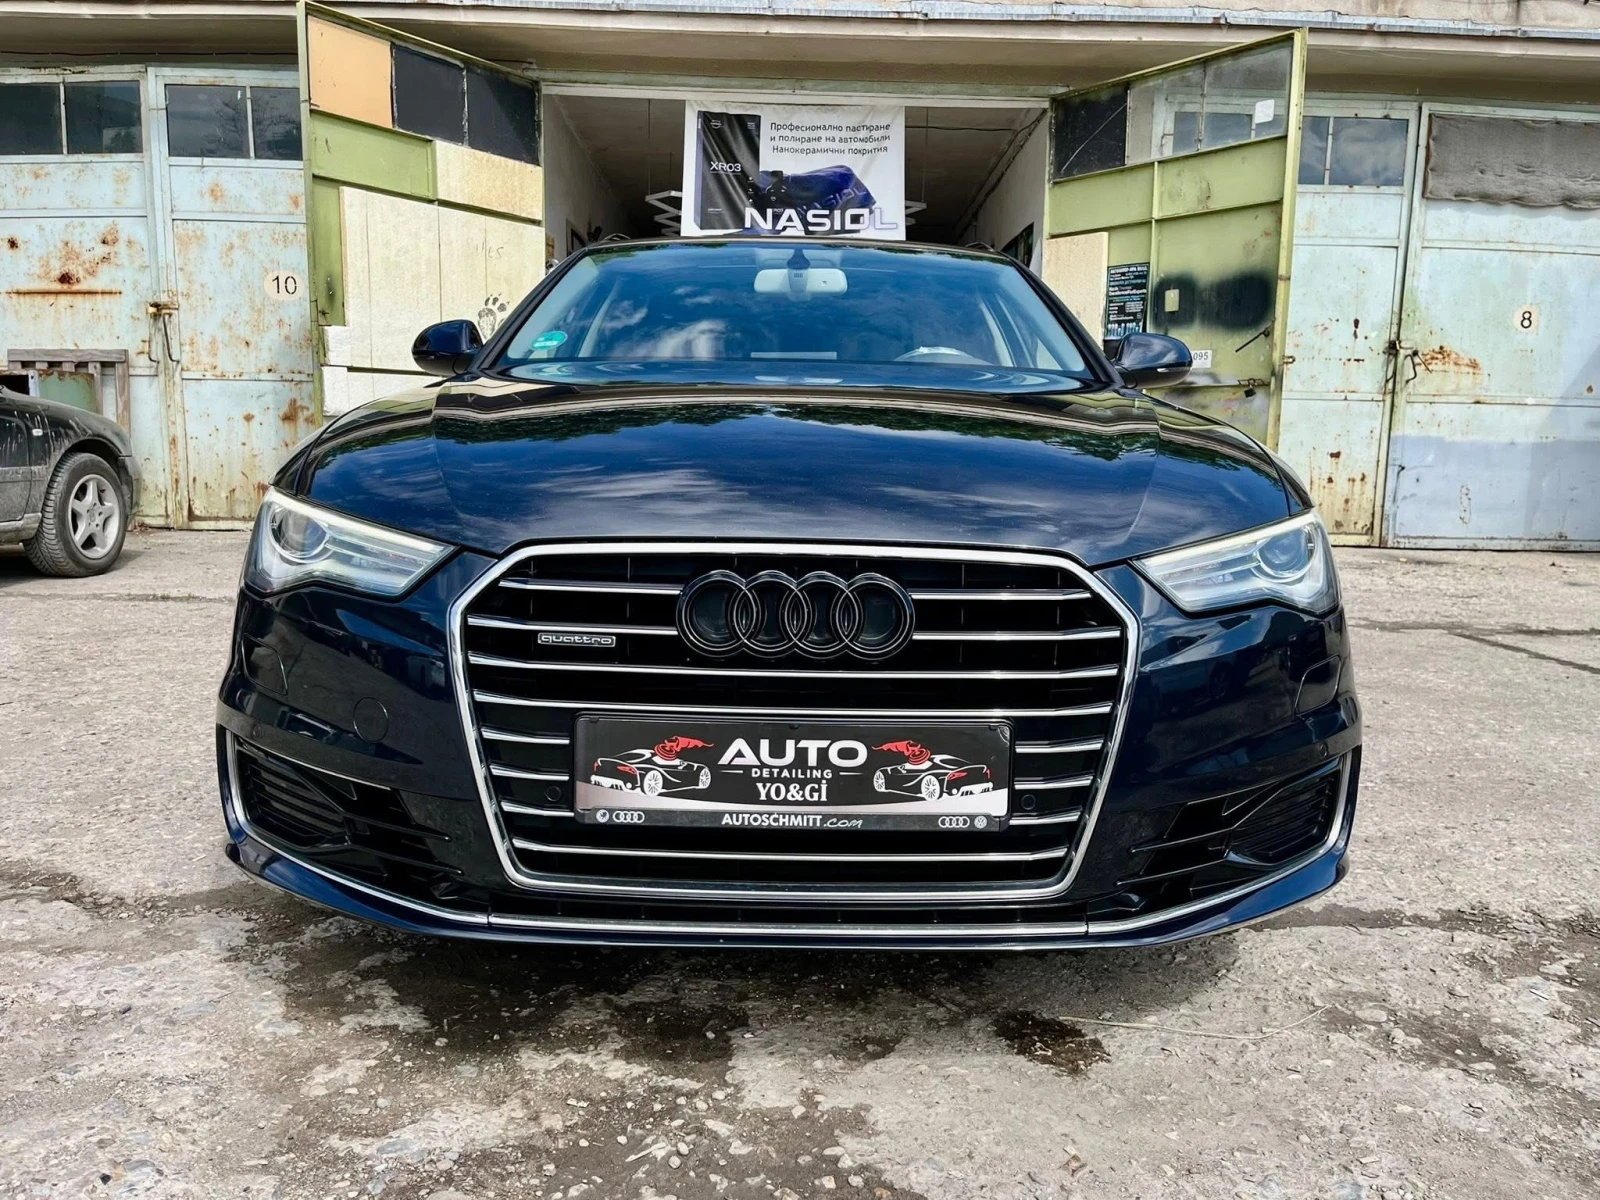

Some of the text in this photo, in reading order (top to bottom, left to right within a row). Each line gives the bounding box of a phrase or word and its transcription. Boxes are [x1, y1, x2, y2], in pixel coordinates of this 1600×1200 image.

[770, 122, 890, 133] Професионално пастиране
[778, 134, 822, 144] полиране
[825, 135, 836, 143] на
[838, 134, 890, 144] автомобили
[772, 145, 888, 156] Нанокерамични покрития
[710, 161, 741, 172] XR03
[744, 207, 898, 231] NASIOL
[272, 275, 297, 295] 10
[1520, 310, 1532, 329] 8
[540, 634, 612, 645] quattro
[717, 737, 868, 768] AUTO
[751, 768, 833, 779] DETAILING
